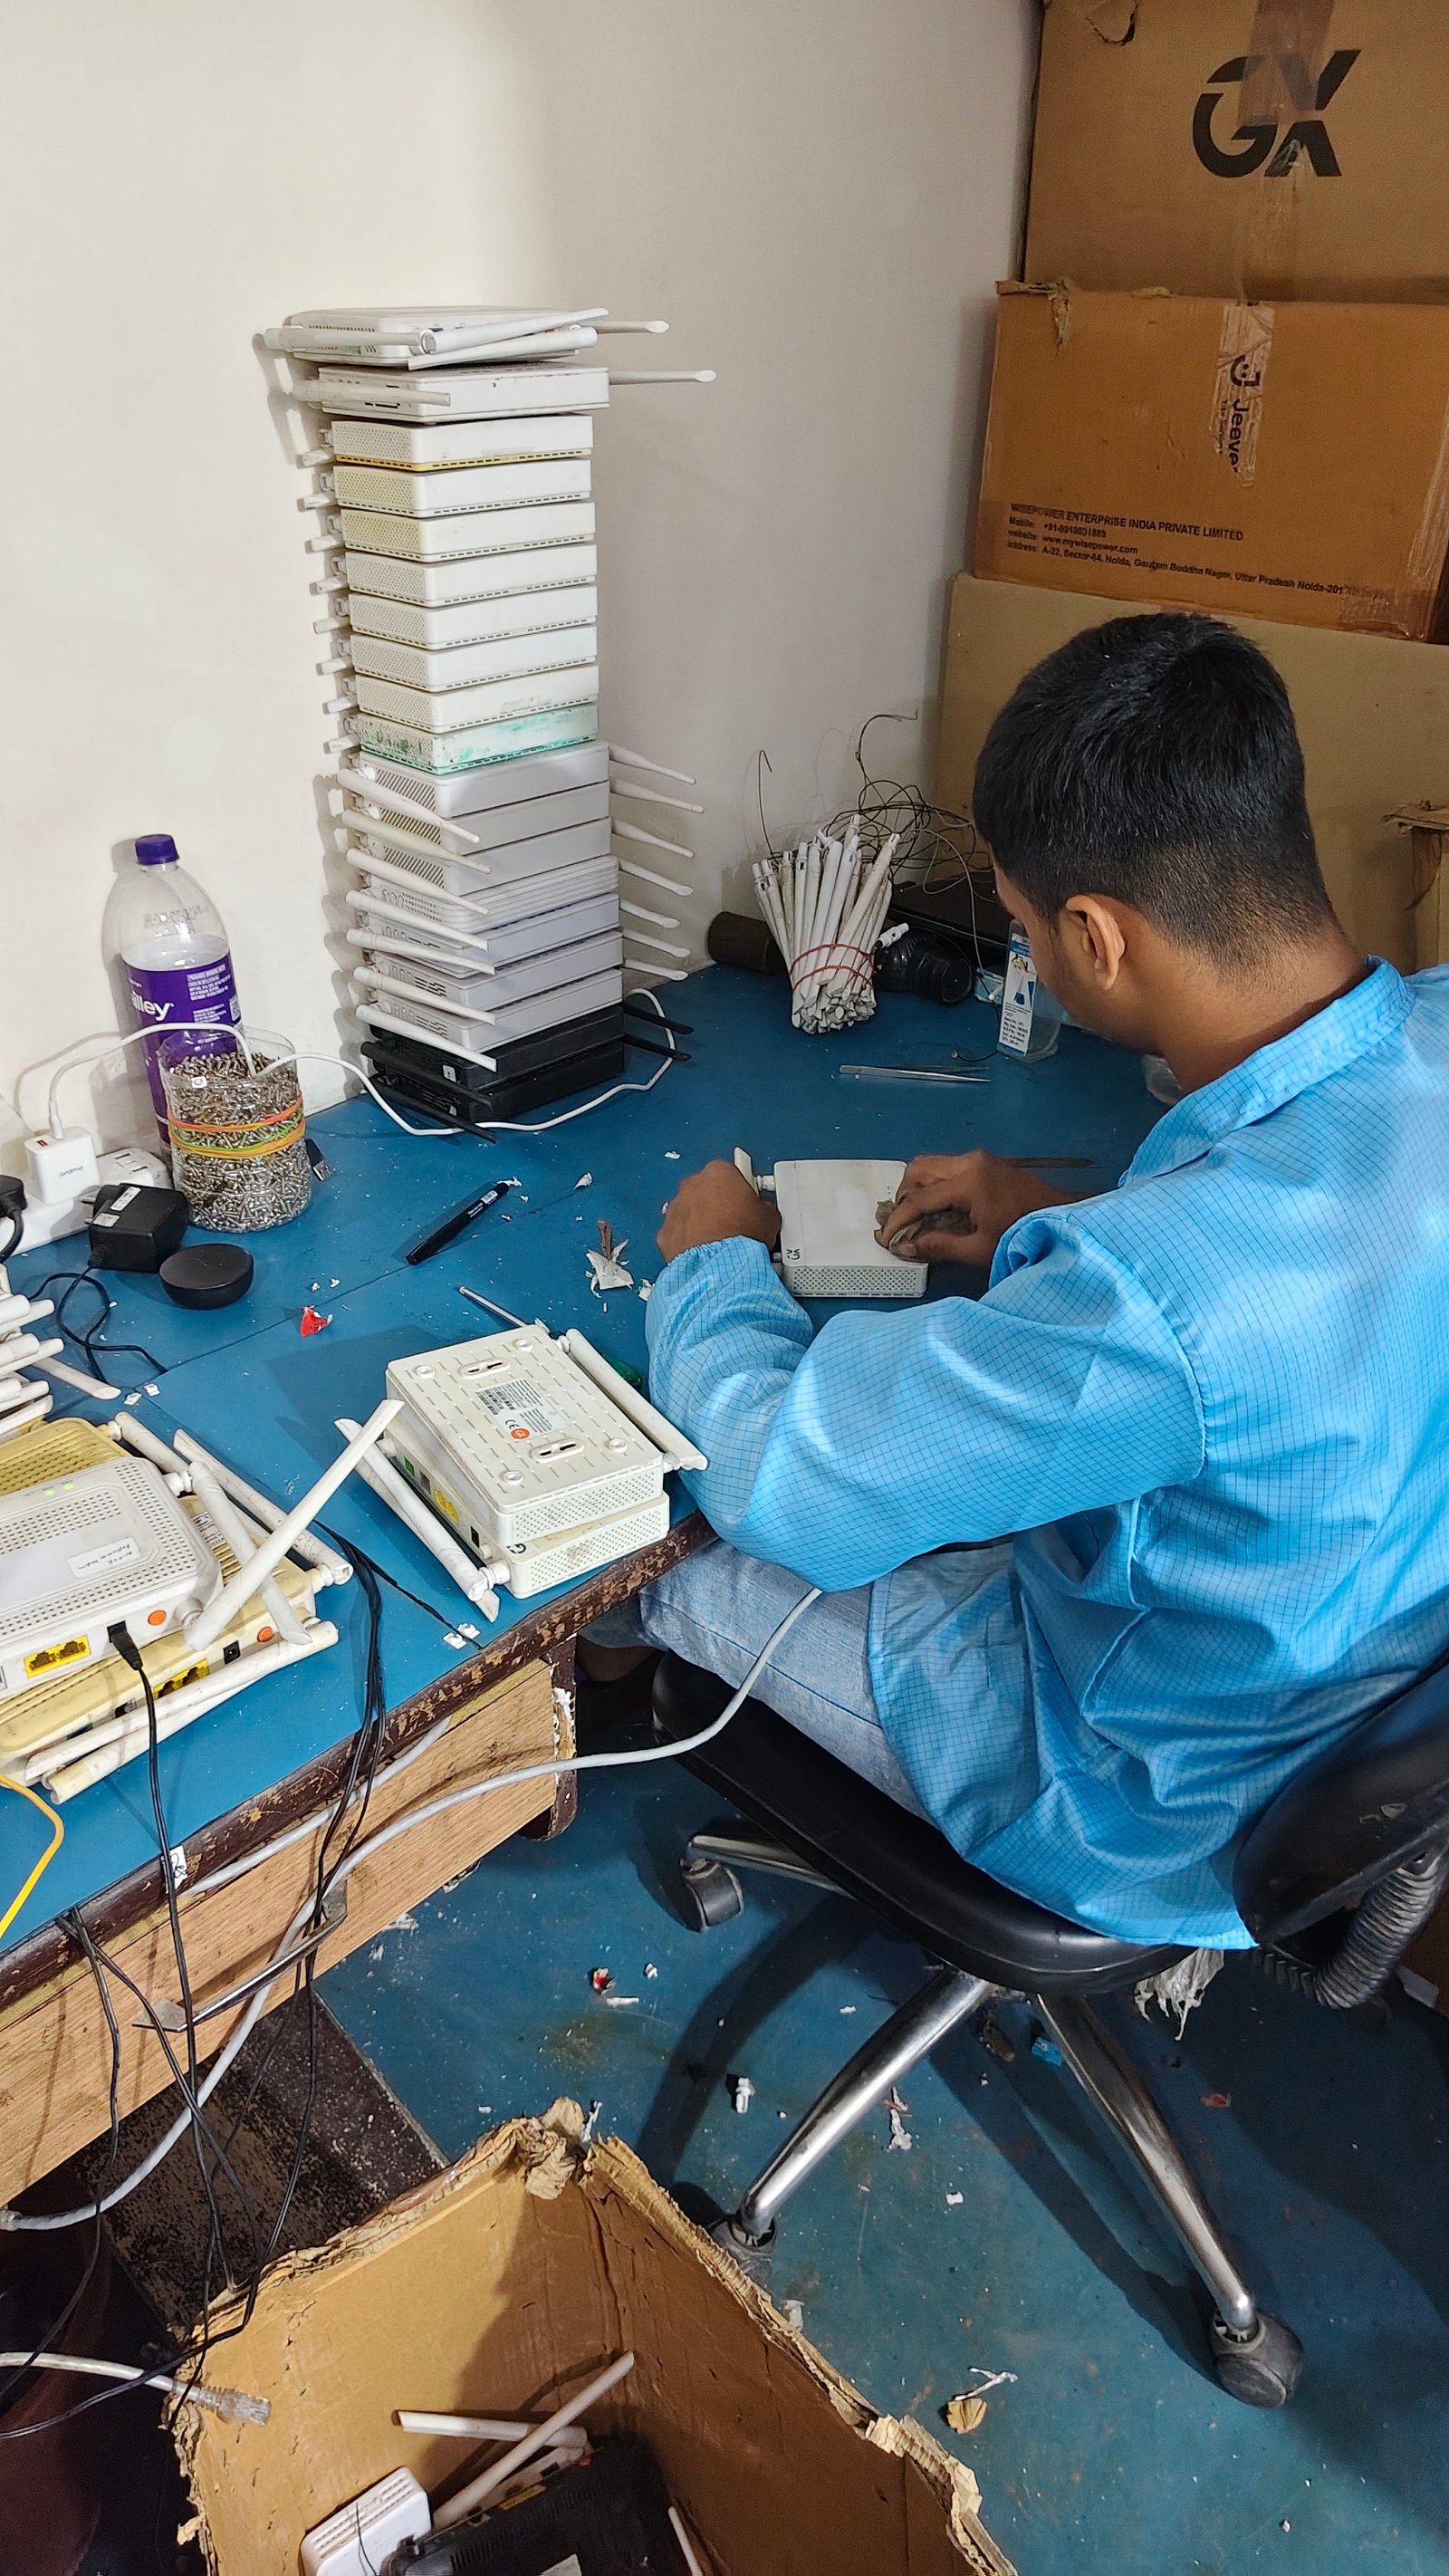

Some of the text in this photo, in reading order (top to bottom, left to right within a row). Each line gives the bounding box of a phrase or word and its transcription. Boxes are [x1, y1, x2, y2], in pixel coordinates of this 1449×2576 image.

[1193, 49, 1361, 178] GX
[1066, 511, 1127, 528] ENTERPRISE
[1128, 518, 1156, 532] INDIA
[1157, 522, 1201, 536] PRIVATE
[1203, 527, 1243, 541] LIMITED
[1258, 574, 1295, 588] Pradesh
